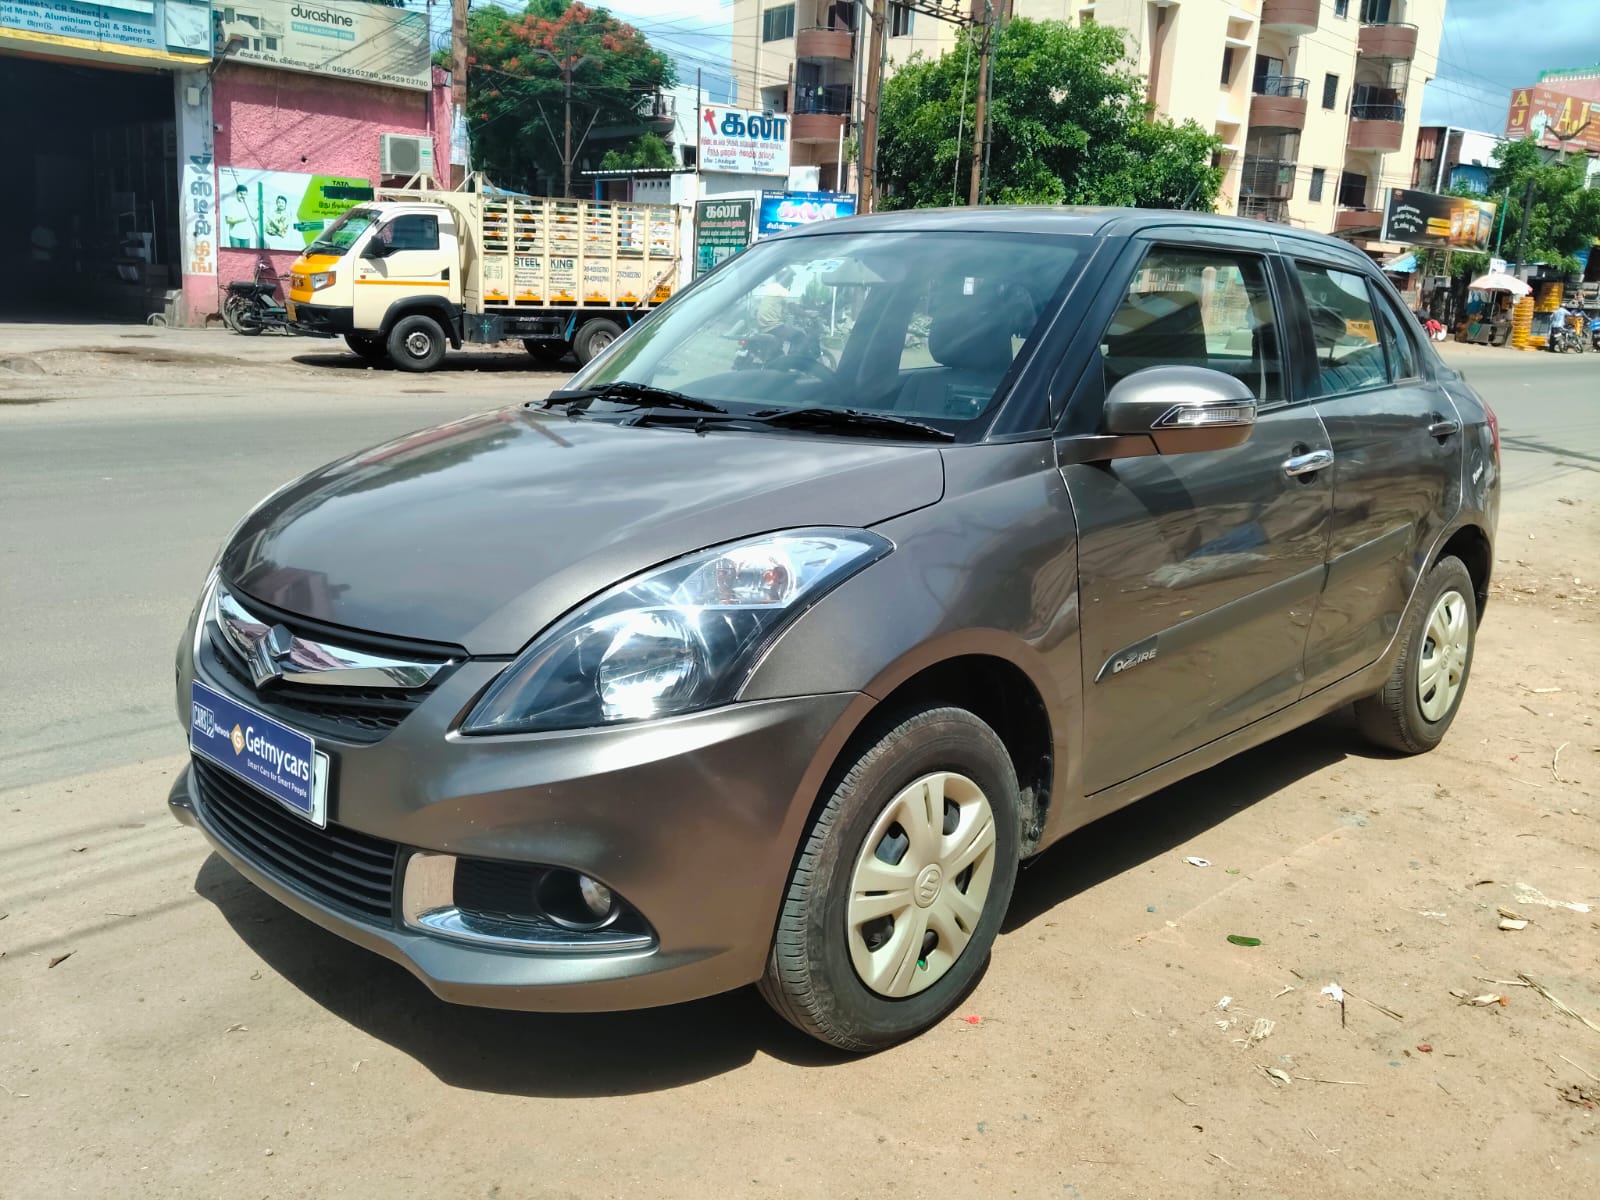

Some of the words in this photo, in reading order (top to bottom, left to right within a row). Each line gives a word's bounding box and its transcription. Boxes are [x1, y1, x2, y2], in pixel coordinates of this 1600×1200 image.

[14, 7, 42, 18] Mesh,
[44, 11, 92, 25] Aluminium
[93, 20, 111, 29] Coil
[122, 24, 151, 35] Sheets
[70, 6, 100, 18] Sheets
[291, 4, 353, 26] durashine
[1512, 90, 1529, 107] A
[720, 112, 787, 141] கலா
[1511, 110, 1528, 126] J
[1554, 97, 1590, 136] AJ
[706, 205, 741, 218] கலா
[513, 256, 541, 267] STEEL
[550, 258, 574, 269] KING
[193, 704, 207, 731] CARS
[214, 723, 230, 740] Network
[245, 726, 309, 781] Getmycars
[247, 758, 260, 773] Smart
[260, 765, 270, 779] Cars
[277, 774, 291, 790] Smart
[291, 782, 308, 798] People
